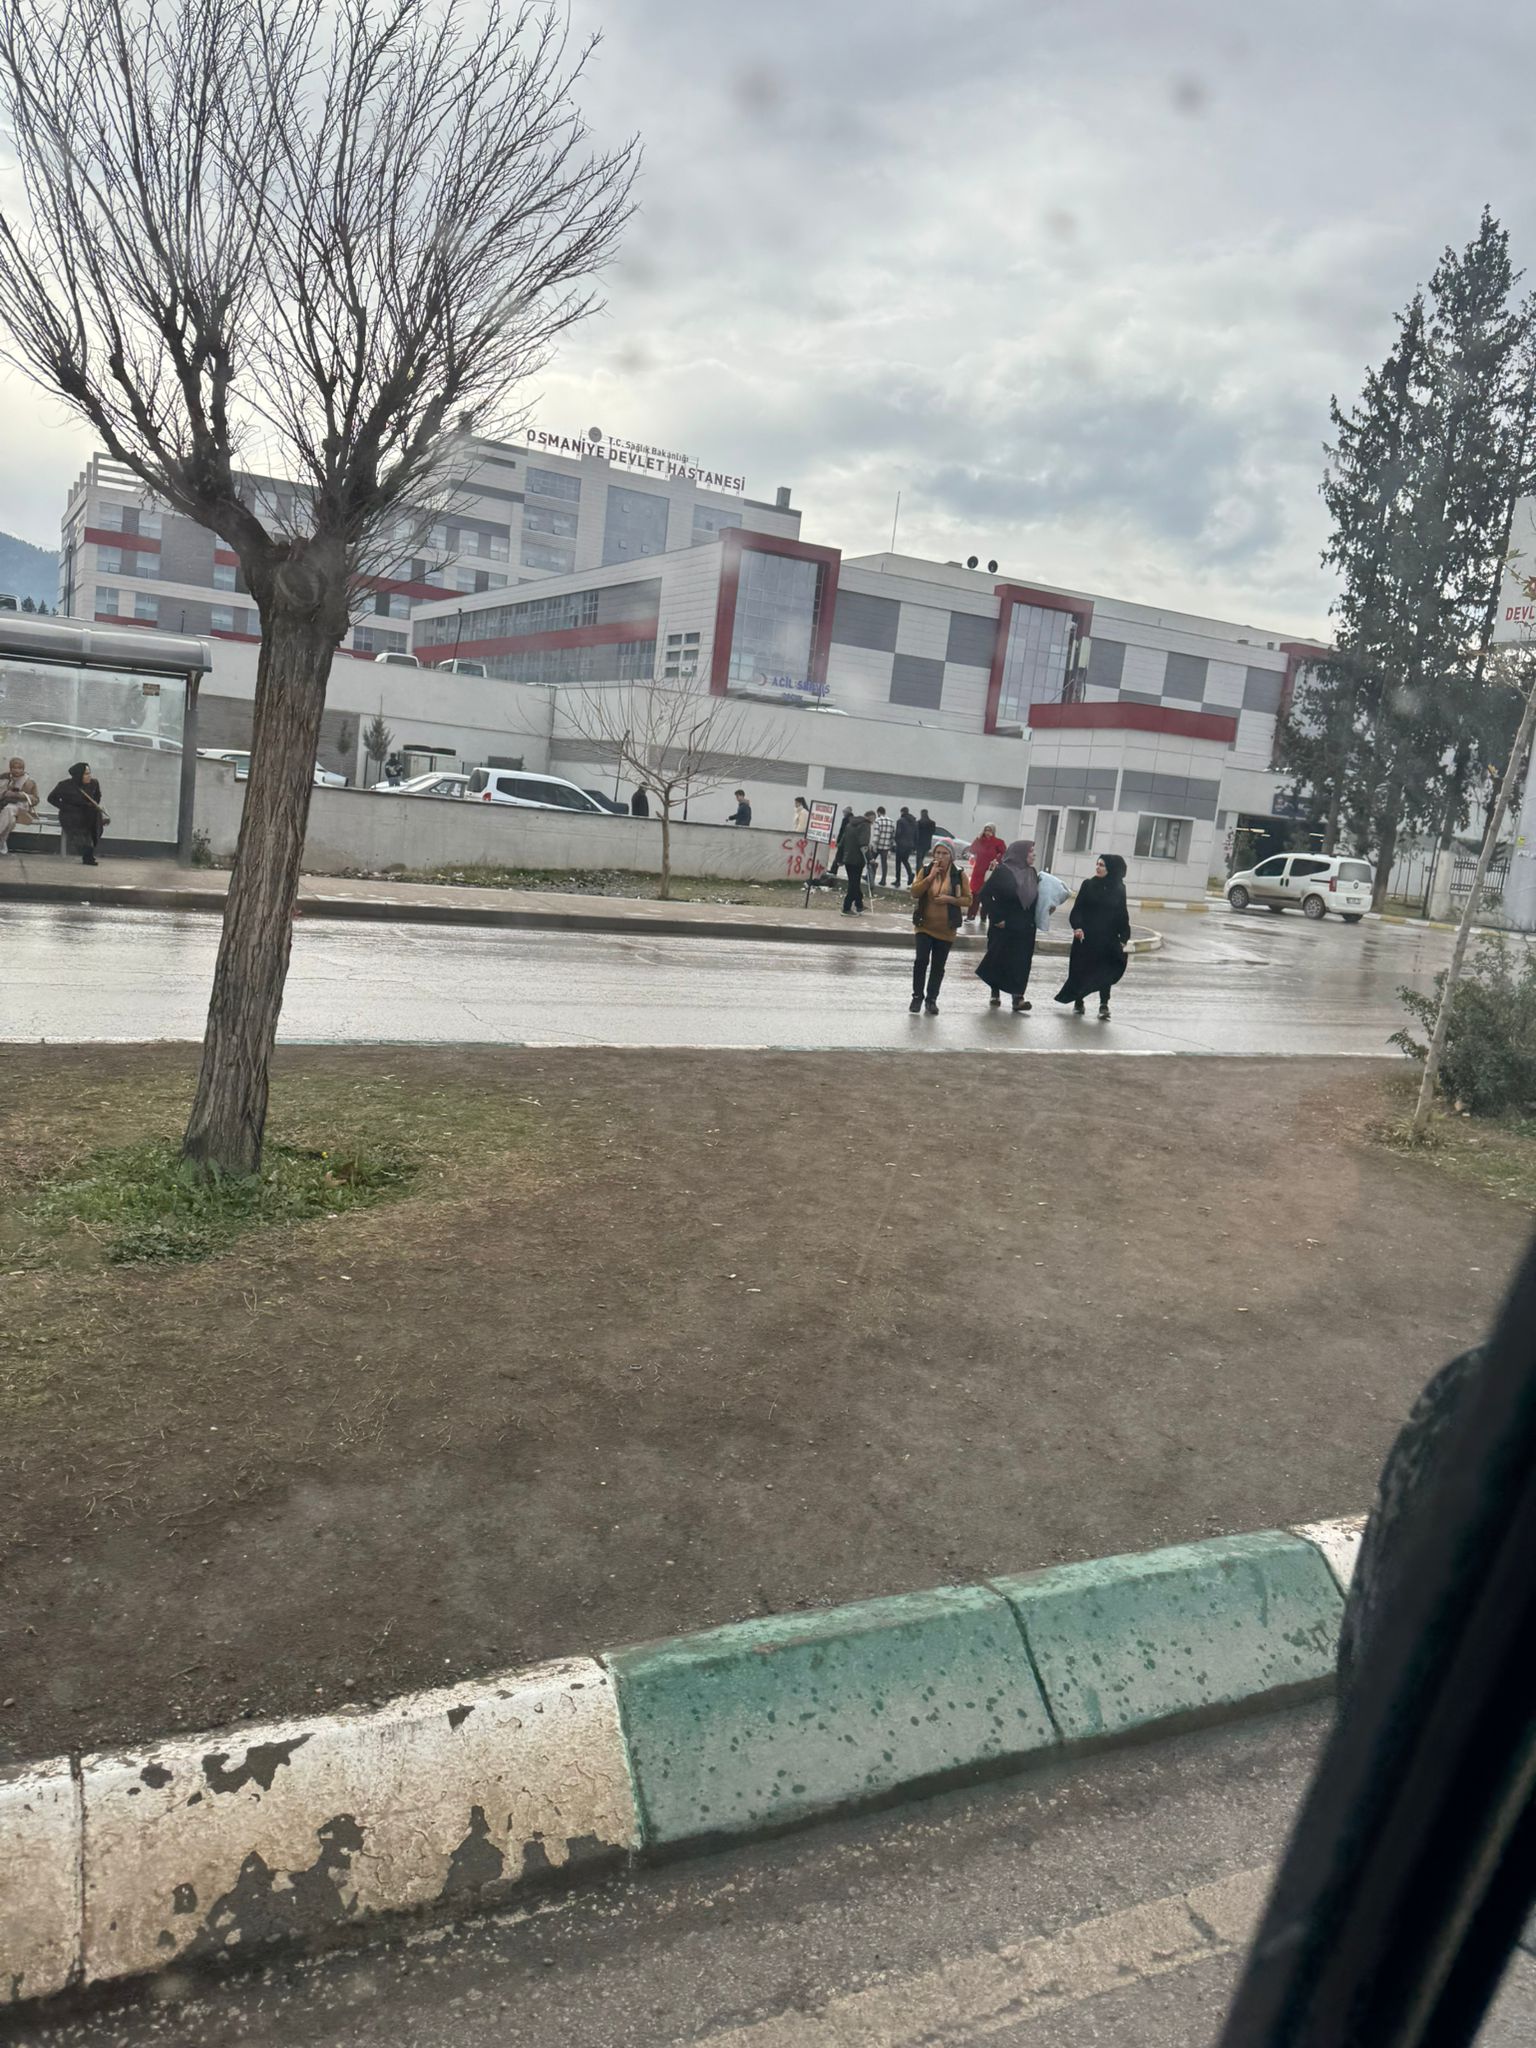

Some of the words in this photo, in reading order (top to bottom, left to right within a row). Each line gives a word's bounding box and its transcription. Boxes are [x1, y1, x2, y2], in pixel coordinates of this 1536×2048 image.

[527, 429, 605, 458] OSMANİYE
[609, 448, 665, 472] DEVLET
[668, 461, 746, 491] HASTANESİ
[625, 441, 651, 455] Sağlık
[651, 447, 689, 464] Bakanlığı
